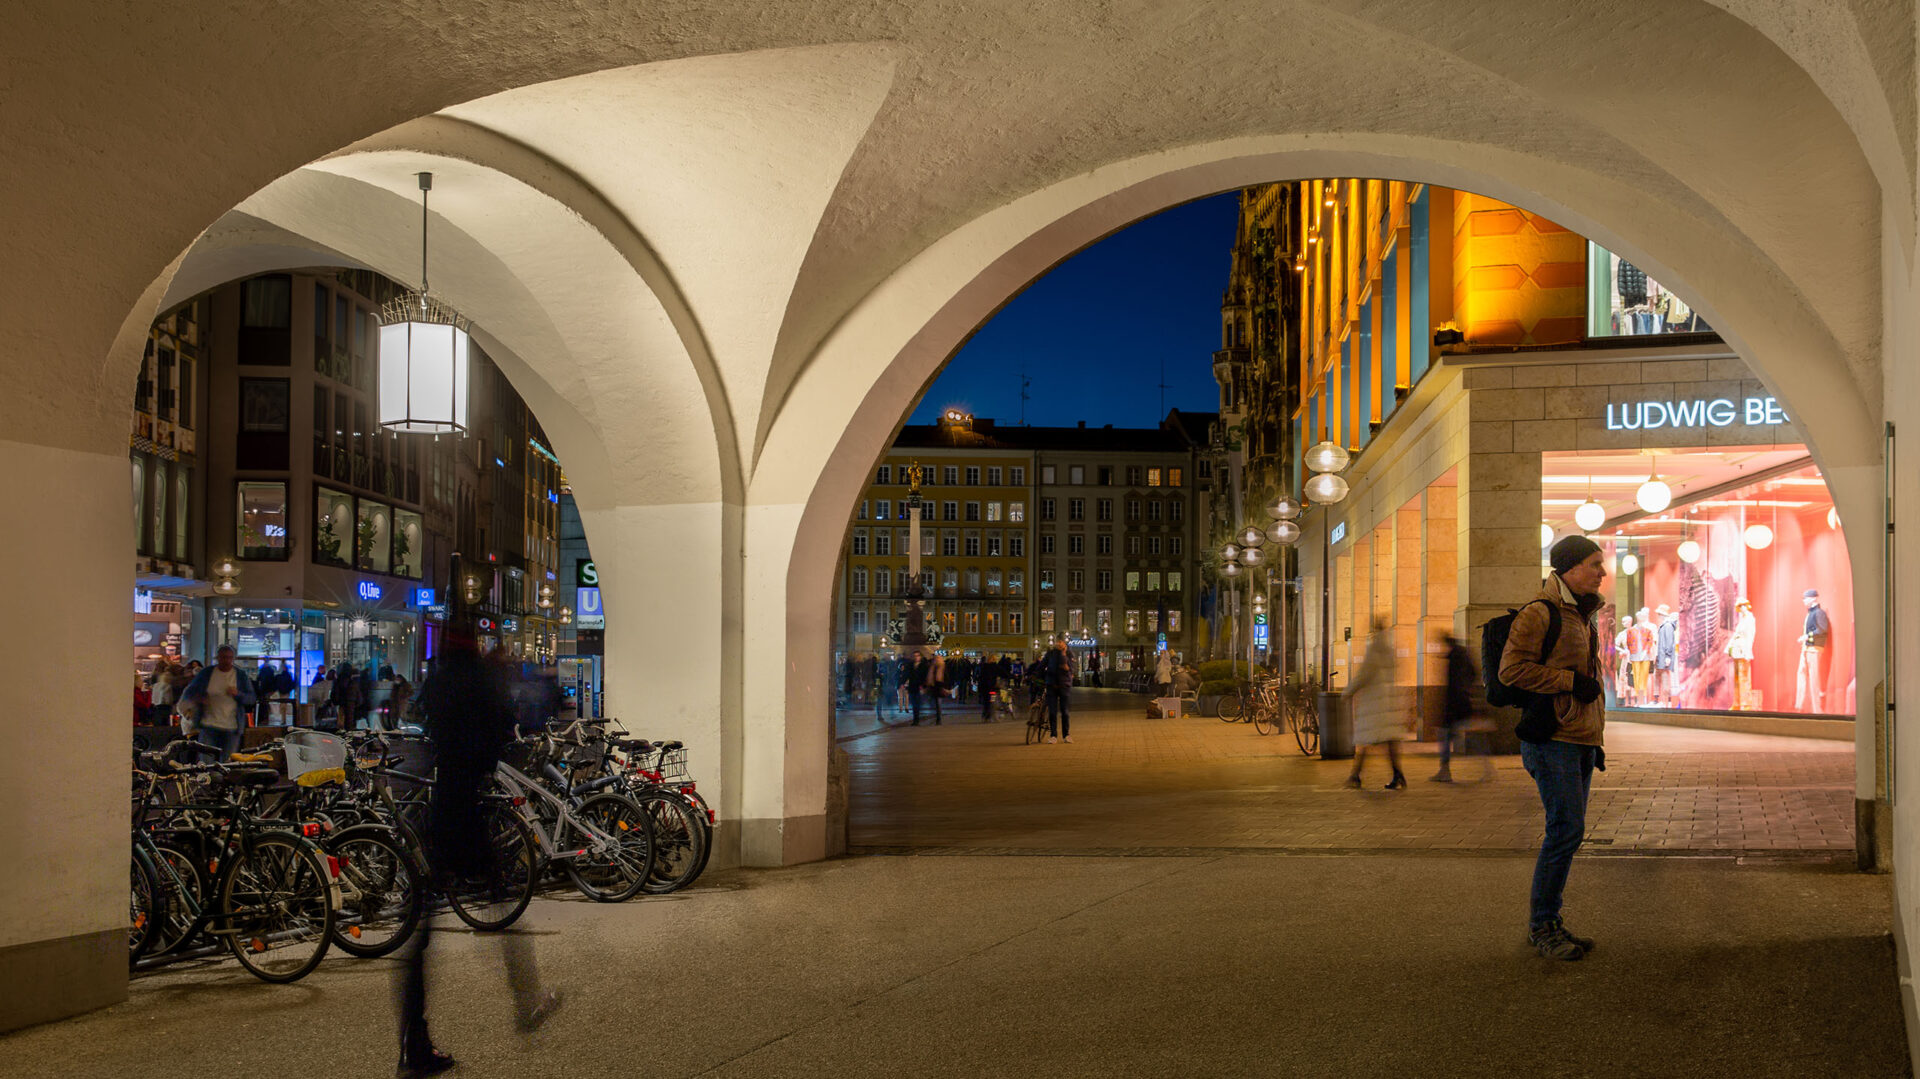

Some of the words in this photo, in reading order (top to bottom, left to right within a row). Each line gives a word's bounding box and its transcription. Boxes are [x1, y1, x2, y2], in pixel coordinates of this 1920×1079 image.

[1607, 399, 1737, 430] LUDWIG
[1745, 397, 1791, 426] BE
[583, 562, 598, 584] S
[367, 582, 380, 599] Live
[582, 590, 599, 612] U
